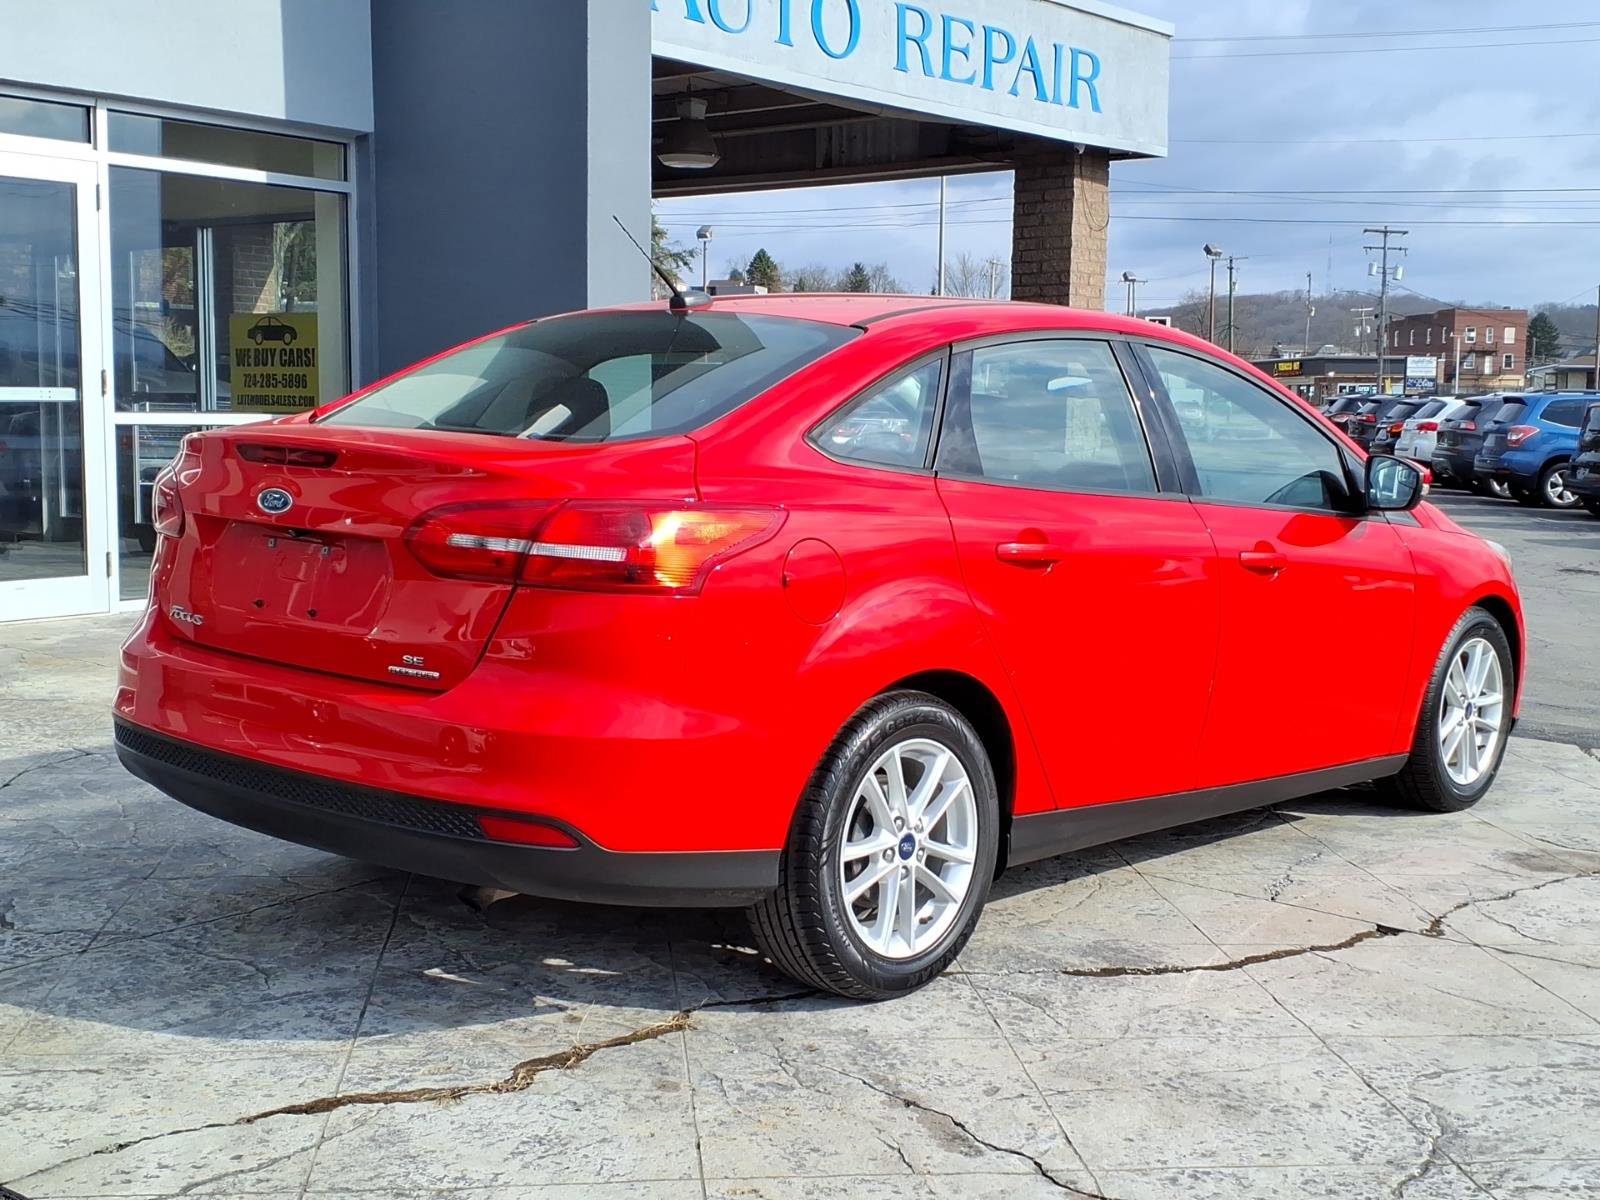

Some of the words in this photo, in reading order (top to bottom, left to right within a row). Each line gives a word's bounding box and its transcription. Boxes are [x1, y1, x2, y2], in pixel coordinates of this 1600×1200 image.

[892, 2, 1103, 114] REPAIR
[235, 347, 252, 367] WE
[253, 347, 277, 367] BUY
[280, 347, 315, 368] CARS!
[243, 373, 307, 389] 724-285-5896
[402, 654, 424, 666] SE
